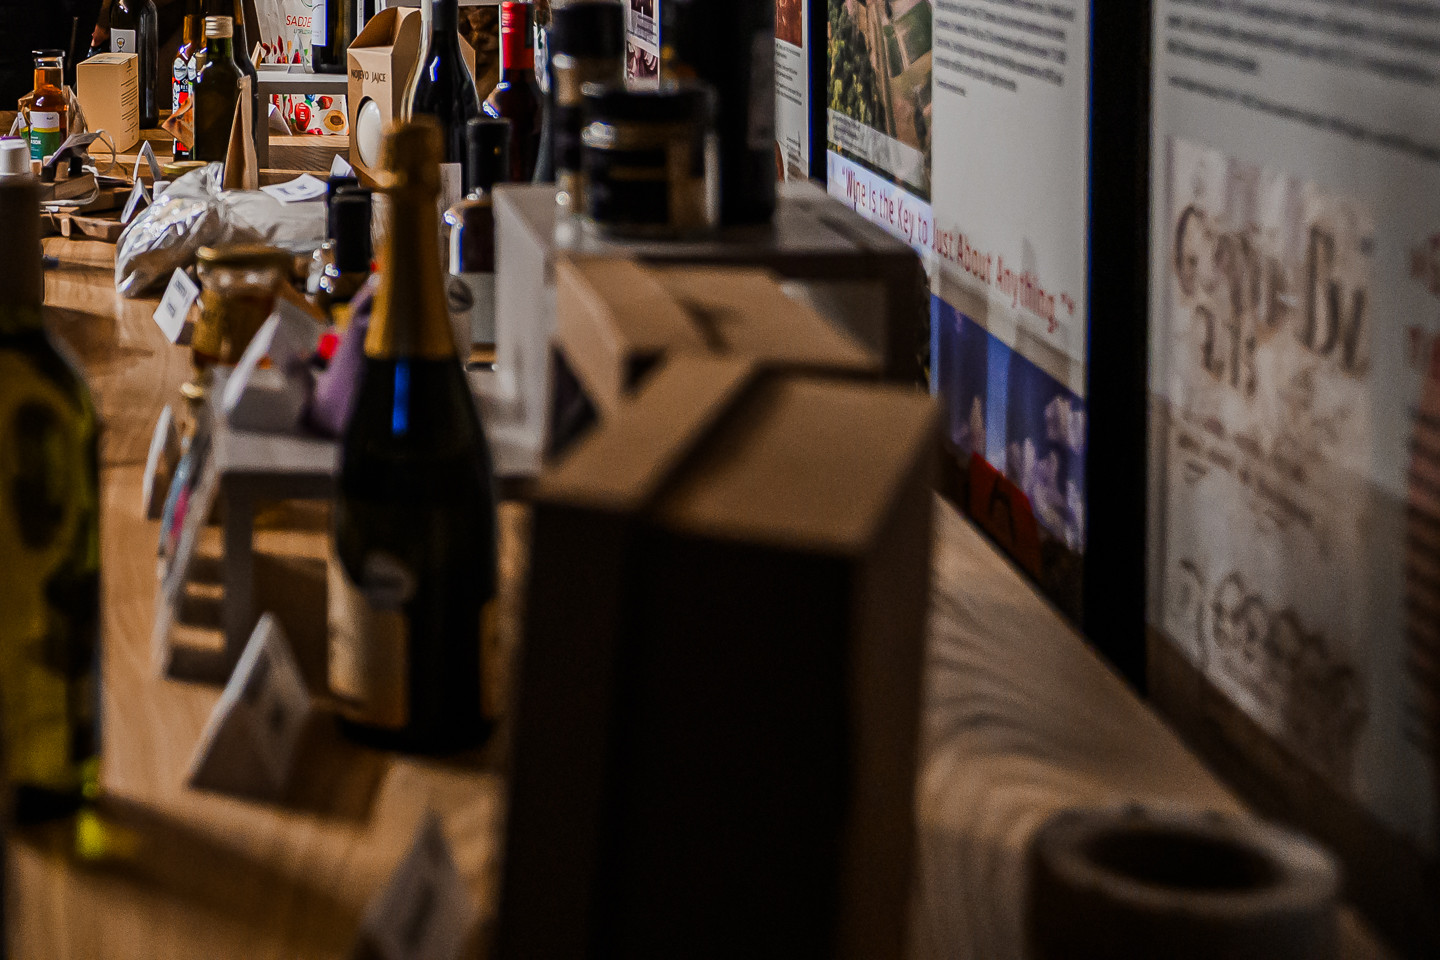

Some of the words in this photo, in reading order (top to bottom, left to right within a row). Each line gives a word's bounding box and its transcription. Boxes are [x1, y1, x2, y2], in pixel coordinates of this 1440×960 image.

[880, 188, 894, 225] the
[897, 197, 914, 244] Key
[918, 211, 928, 246] to
[932, 217, 954, 262] Just
[957, 233, 991, 286] About
